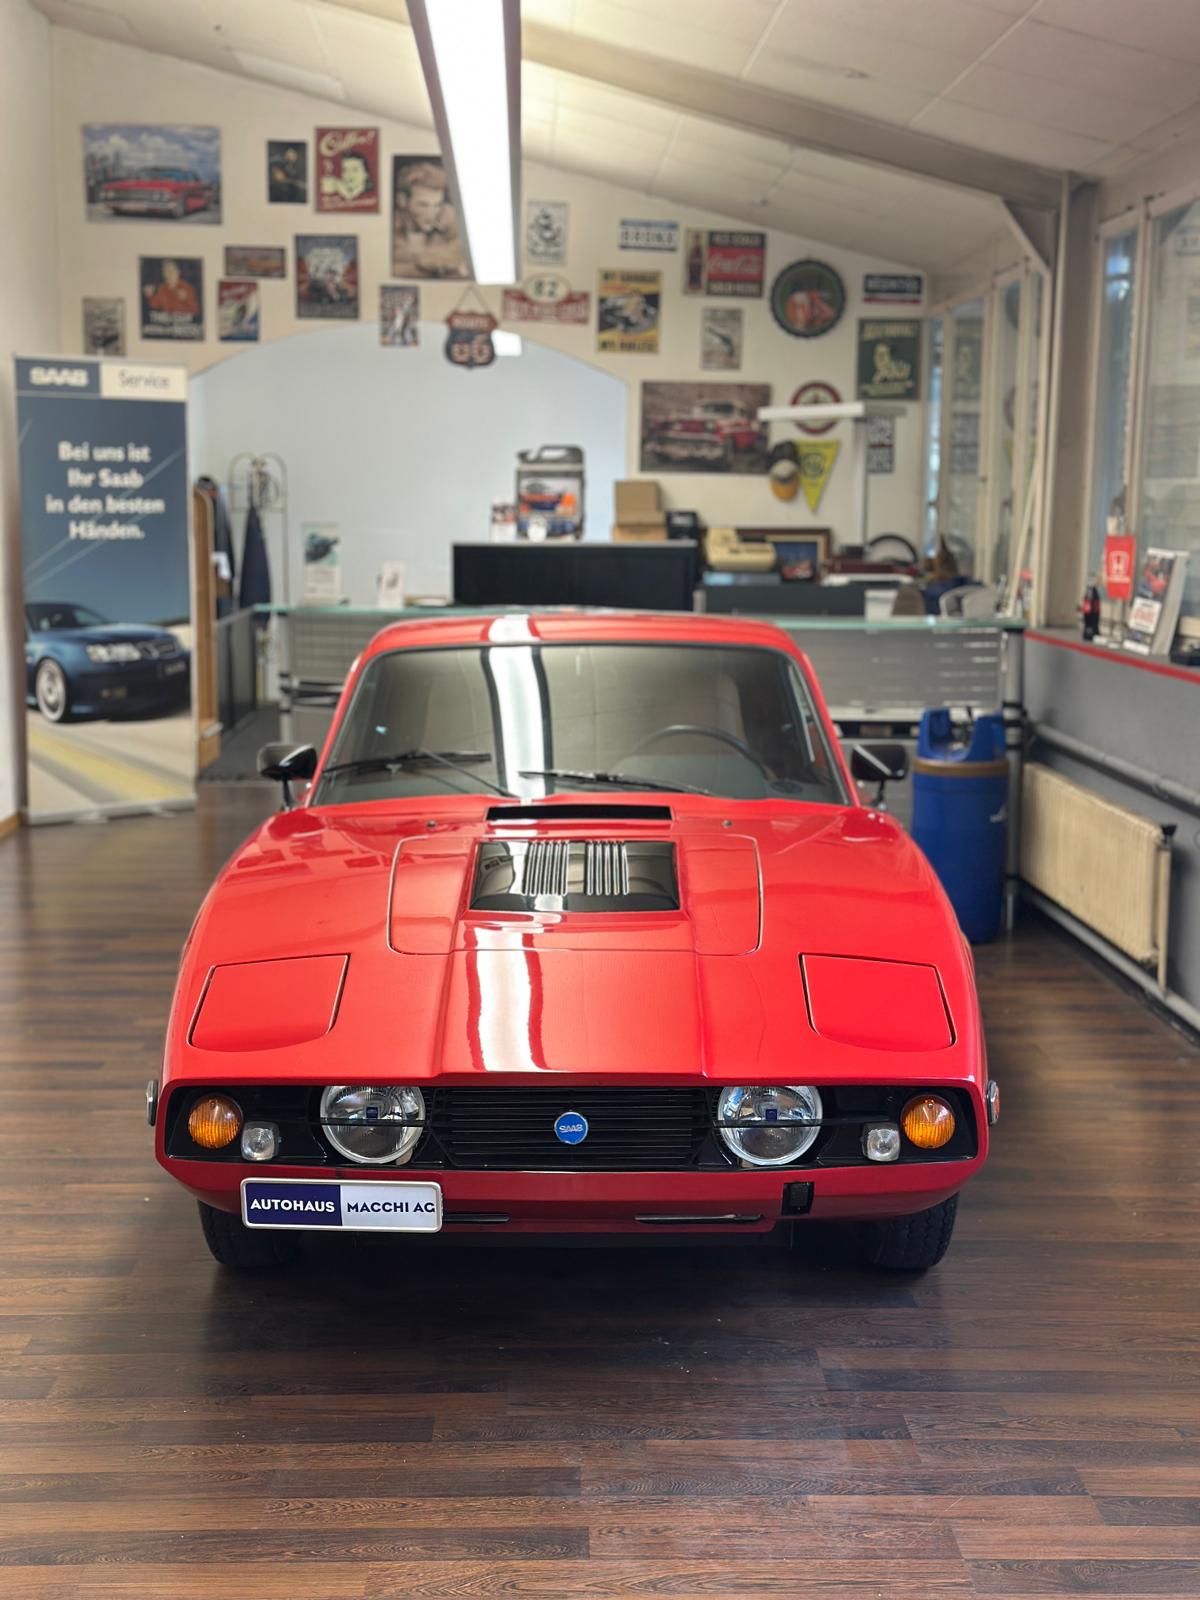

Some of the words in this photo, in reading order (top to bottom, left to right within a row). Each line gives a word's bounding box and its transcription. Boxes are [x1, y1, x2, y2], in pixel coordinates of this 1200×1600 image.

[118, 369, 170, 389] Service
[58, 441, 89, 461] Bei
[93, 446, 124, 462] uns
[127, 443, 151, 462] ist
[67, 468, 95, 487] Ihr
[99, 468, 144, 488] Saab
[46, 494, 64, 513] in
[68, 495, 102, 513] den
[105, 494, 165, 513] besten
[69, 520, 145, 539] Händen.
[251, 1199, 335, 1213] AUTOHAUS
[347, 1202, 409, 1213] MACCHI
[413, 1202, 436, 1213] AG
